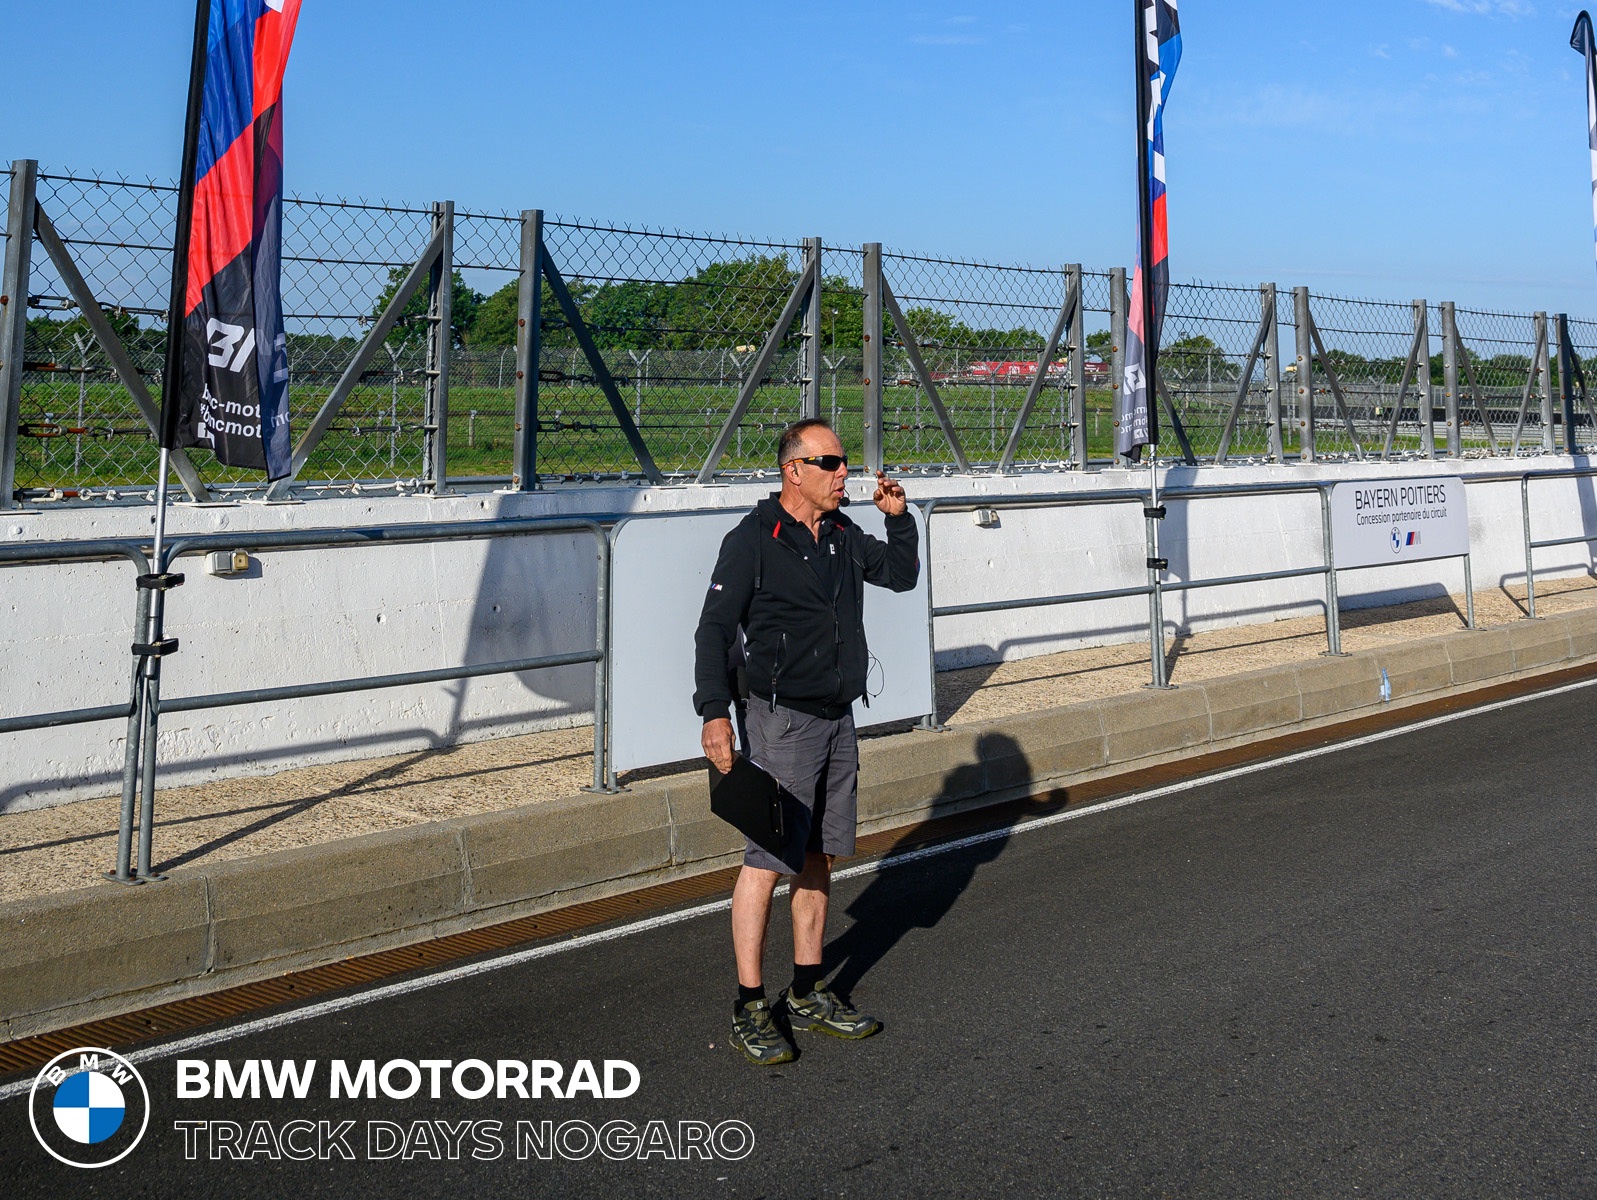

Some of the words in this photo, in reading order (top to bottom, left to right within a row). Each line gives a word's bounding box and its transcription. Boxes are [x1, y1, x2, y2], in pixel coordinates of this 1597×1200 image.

[1355, 488, 1398, 510] BAYERN
[1401, 484, 1446, 506] POITIERS
[1356, 511, 1391, 526] Concession
[1392, 509, 1421, 525] partenaire
[1422, 508, 1430, 519] du
[1431, 506, 1447, 518] circuit
